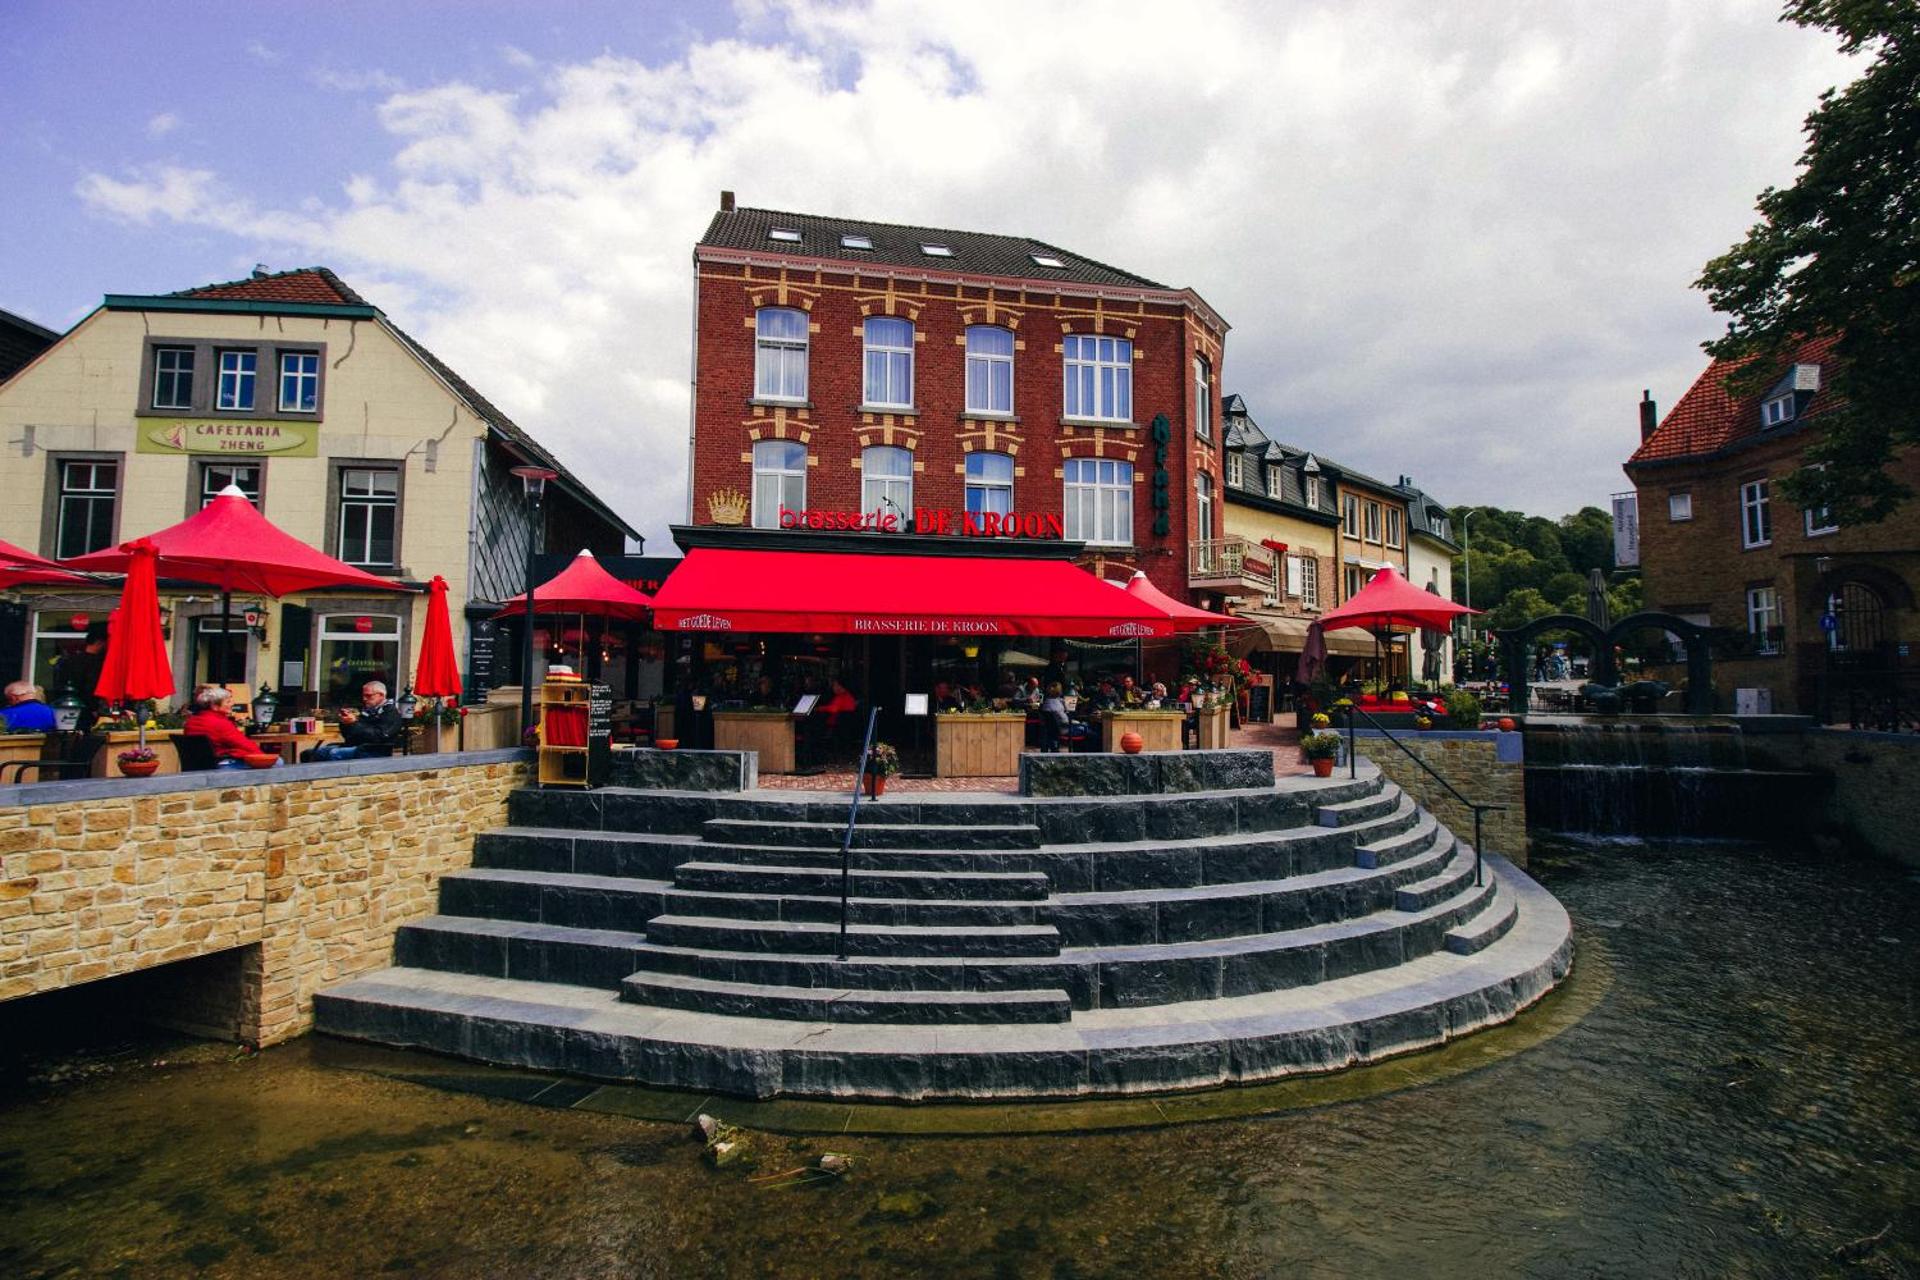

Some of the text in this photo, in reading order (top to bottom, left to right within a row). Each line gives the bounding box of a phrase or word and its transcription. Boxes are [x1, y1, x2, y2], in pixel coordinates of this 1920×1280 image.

[195, 424, 281, 437] CAFETARIA
[220, 440, 265, 450] ZHENG
[779, 503, 1064, 540] brasserie DE KROON
[855, 619, 998, 632] BRASSERIE DE KROON
